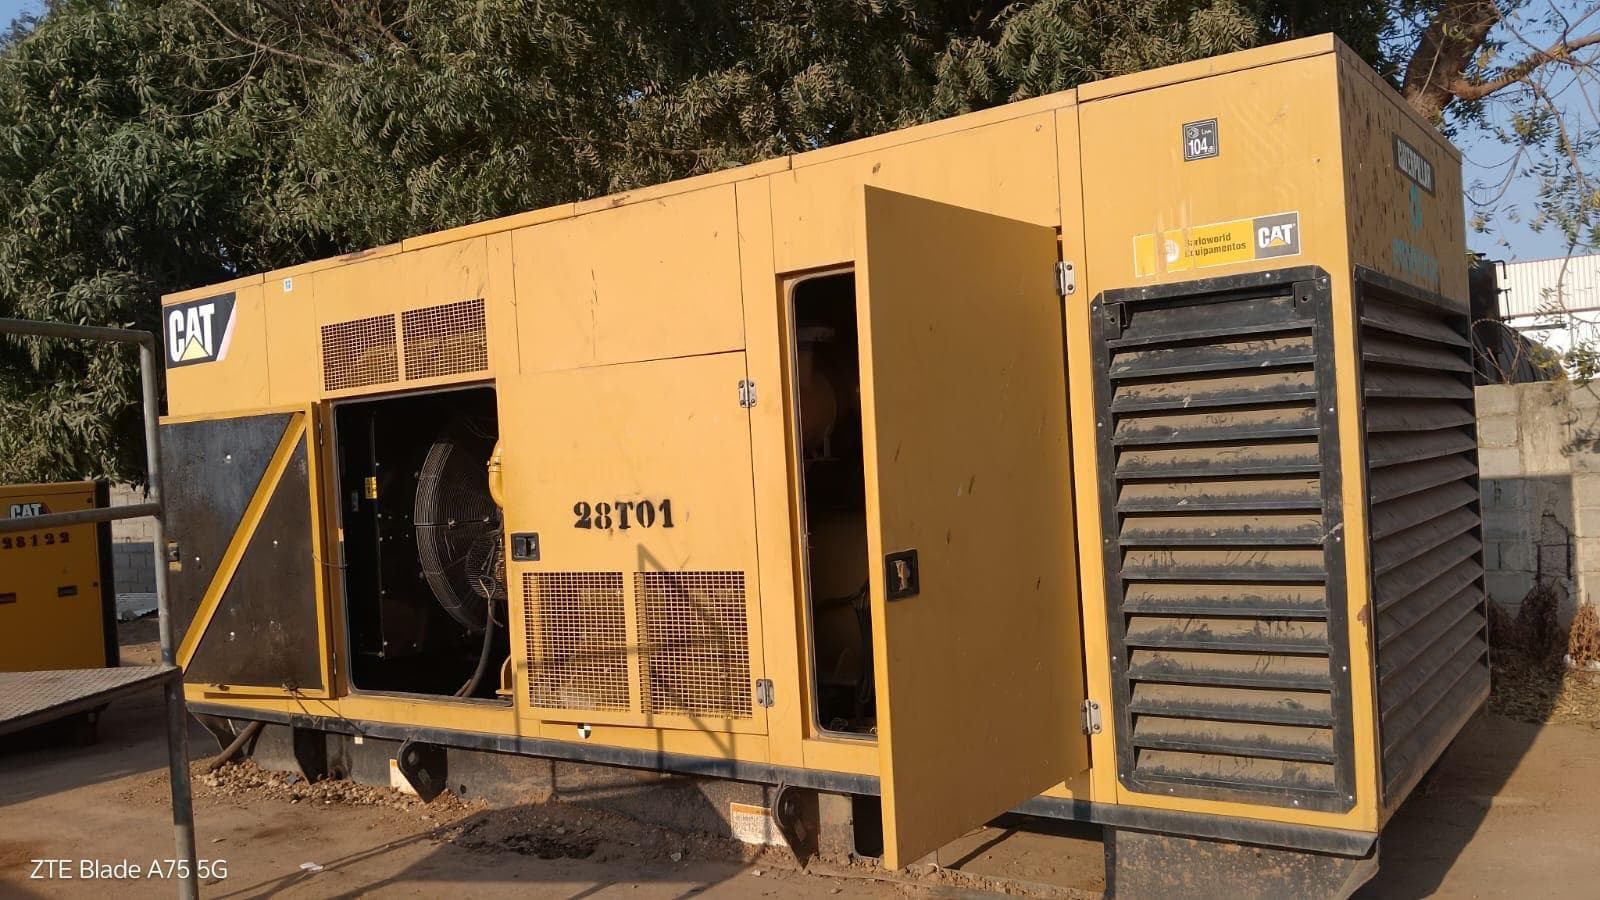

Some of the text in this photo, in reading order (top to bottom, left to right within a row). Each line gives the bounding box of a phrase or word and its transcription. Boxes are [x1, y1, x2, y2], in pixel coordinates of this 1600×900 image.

[1187, 137, 1208, 156] 104
[1257, 224, 1293, 249] CAT
[169, 303, 215, 362] CAT
[10, 503, 42, 520] CAT
[573, 498, 674, 530] 28T01
